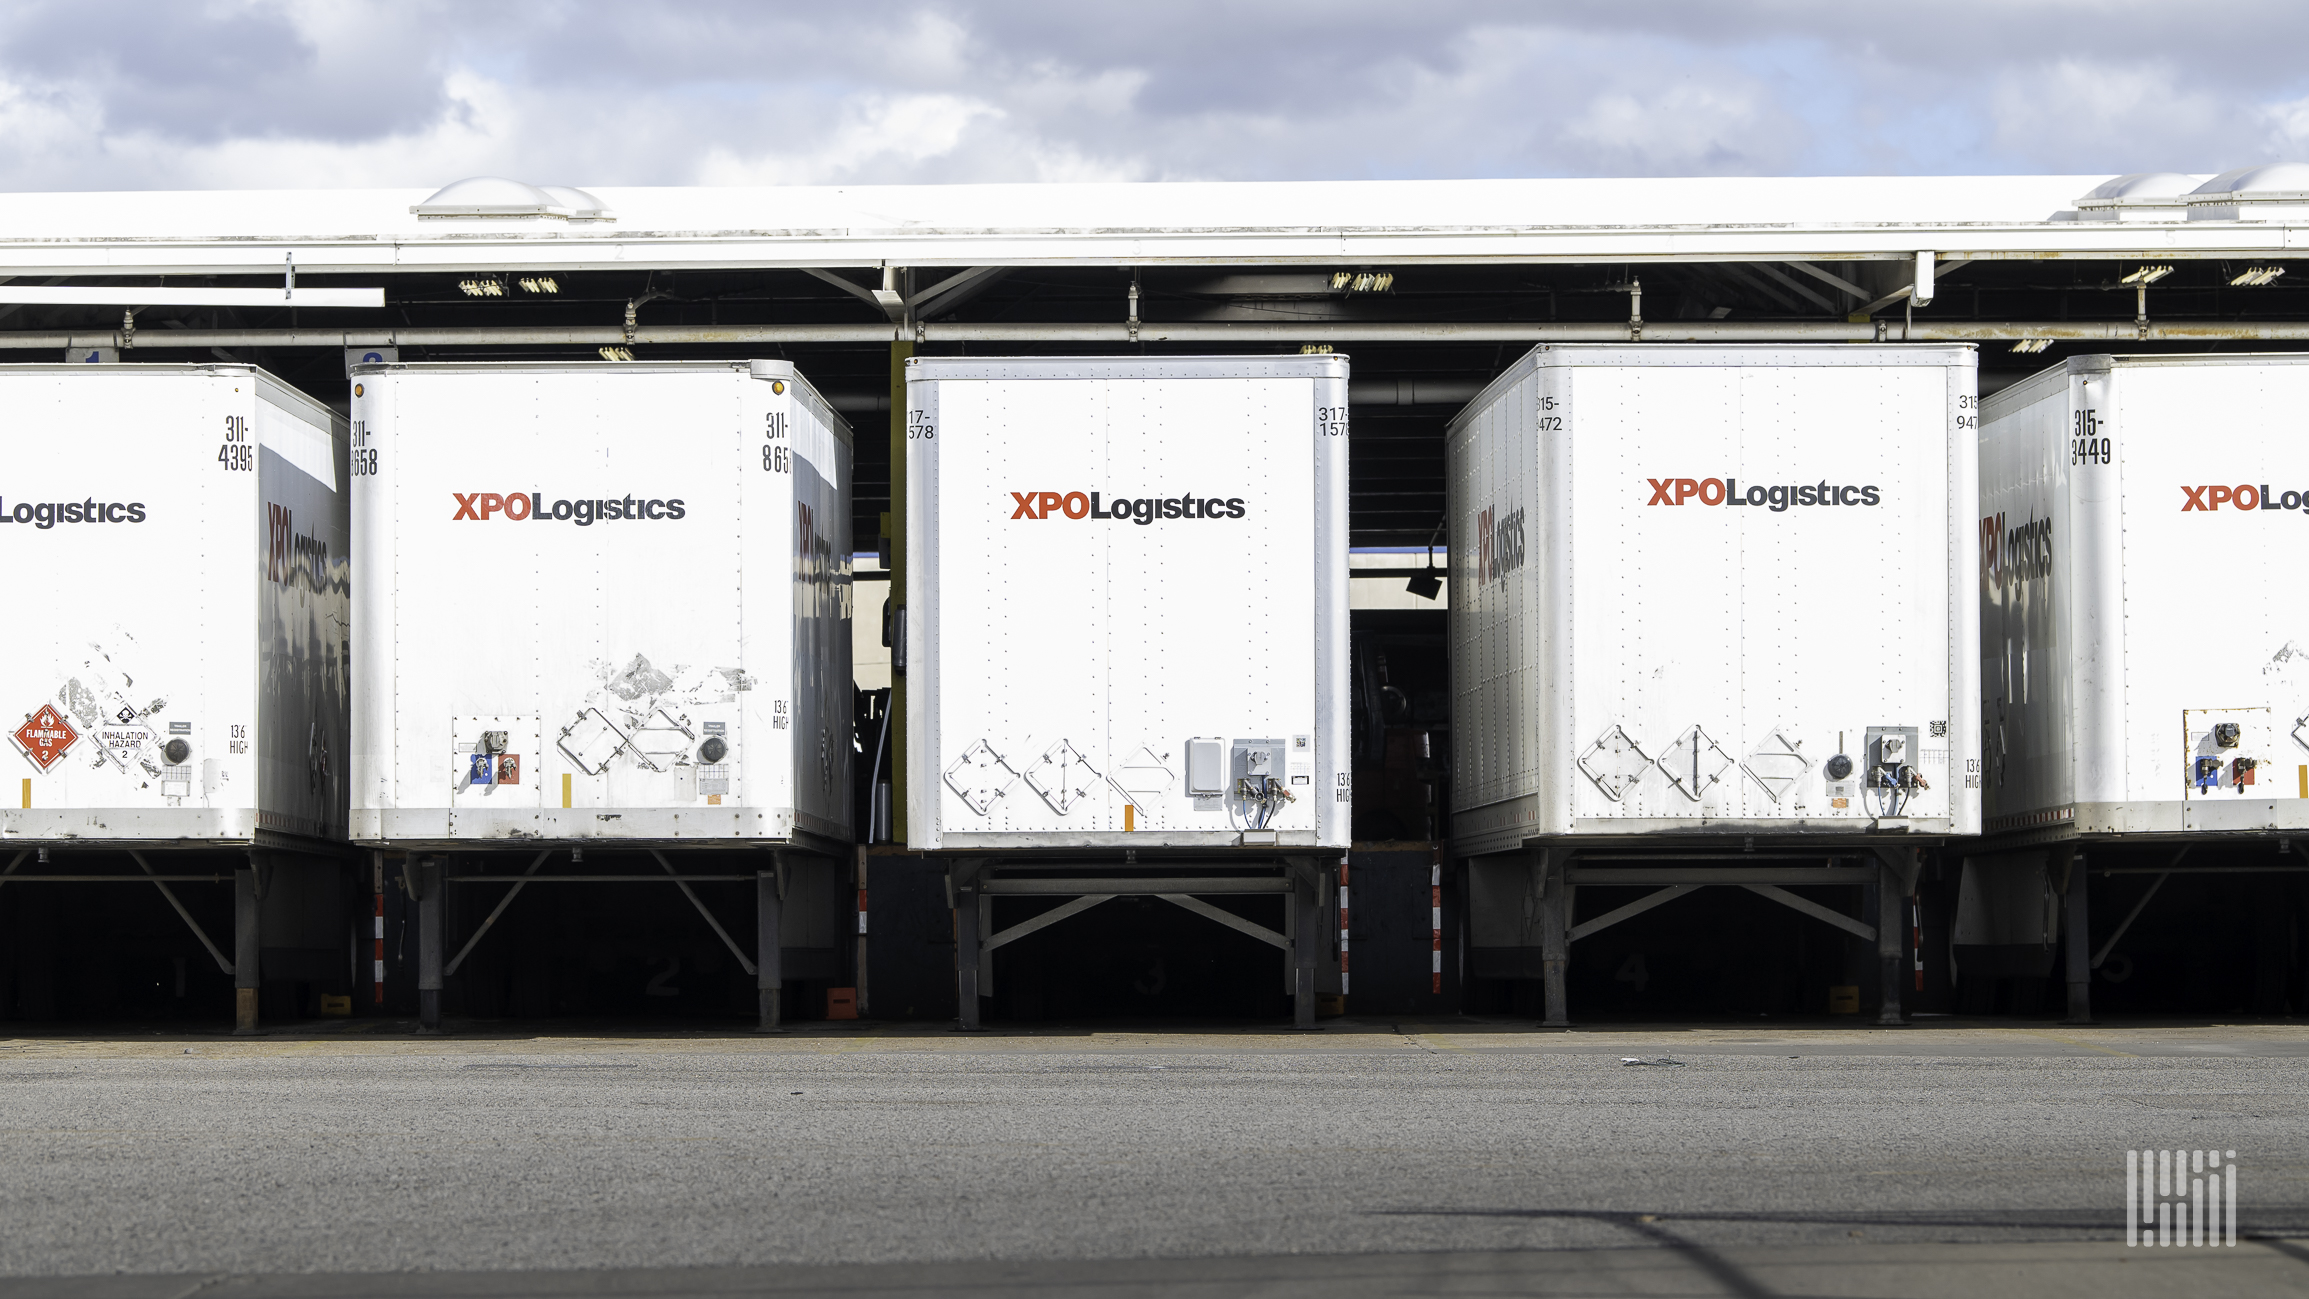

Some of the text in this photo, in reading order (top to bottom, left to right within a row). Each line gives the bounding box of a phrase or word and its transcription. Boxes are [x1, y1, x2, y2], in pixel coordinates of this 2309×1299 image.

[225, 416, 249, 443] 311-
[767, 412, 789, 440] 311-
[909, 425, 934, 439] 578
[2075, 409, 2104, 437] 315-
[352, 420, 371, 447] 311-
[218, 444, 253, 472] 4395
[2071, 437, 2111, 466] 3449
[26, 728, 67, 740] FLAMMABLE
[102, 731, 149, 741] INHALATION
[108, 740, 142, 749] HAZARD
[122, 750, 128, 759] 2
[42, 750, 49, 761] 2
